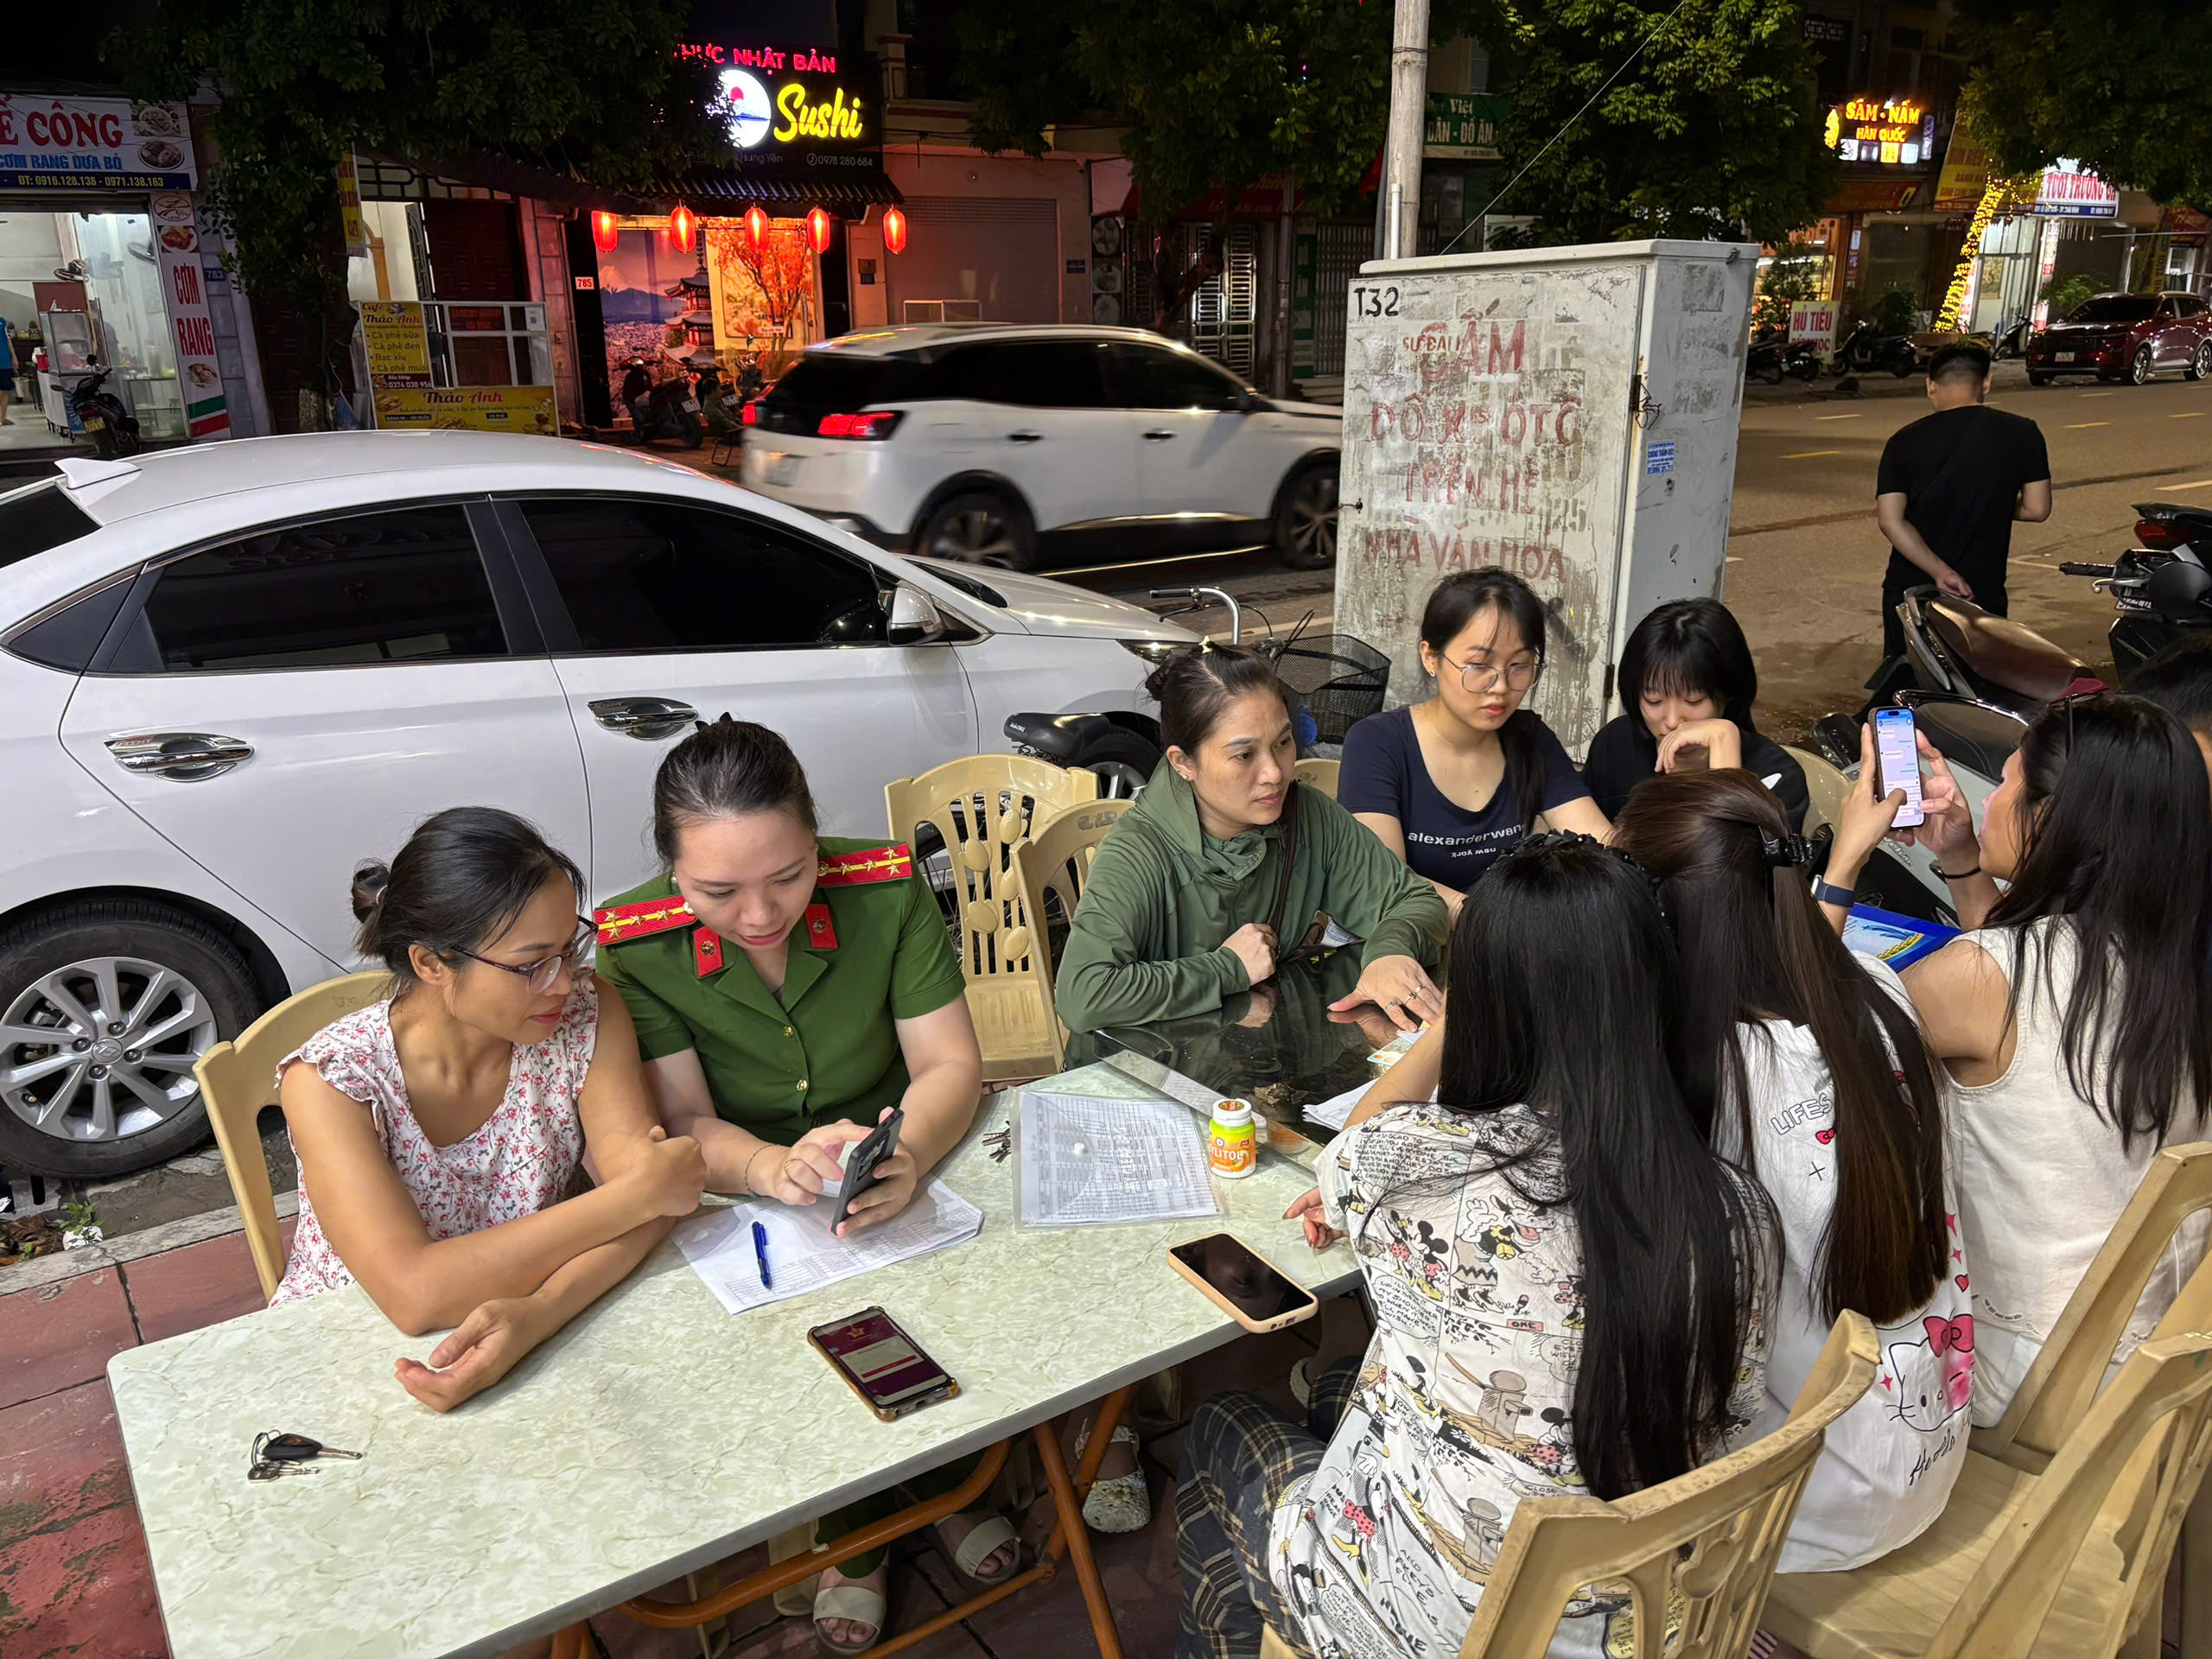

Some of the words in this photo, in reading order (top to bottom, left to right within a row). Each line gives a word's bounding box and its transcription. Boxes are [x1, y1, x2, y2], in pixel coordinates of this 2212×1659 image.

[733, 47, 785, 75] NHẬT
[793, 48, 836, 73] BẢN
[773, 83, 862, 142] Sushi
[1450, 99, 1473, 118] Việt
[27, 101, 123, 148] CÔNG
[1856, 125, 1877, 140] HÀN
[1878, 126, 1906, 143] QUỐC
[31, 155, 69, 169] RANG
[73, 156, 100, 169] DƯA
[104, 153, 122, 170] BÒ
[766, 153, 783, 162] Yên
[817, 157, 837, 167] 0978
[839, 157, 855, 167] 280
[857, 158, 873, 167] 684
[18, 175, 34, 185] ĐT:
[35, 176, 97, 186] 0916.128.136
[105, 177, 163, 187] 0971.138.163
[174, 264, 200, 304] CƠM
[1353, 287, 1400, 317] T32
[176, 317, 214, 355] RANG
[1420, 298, 1526, 380] CẤM
[423, 391, 464, 404] Thảo
[469, 391, 504, 403] Anh
[1475, 847, 1497, 858] new
